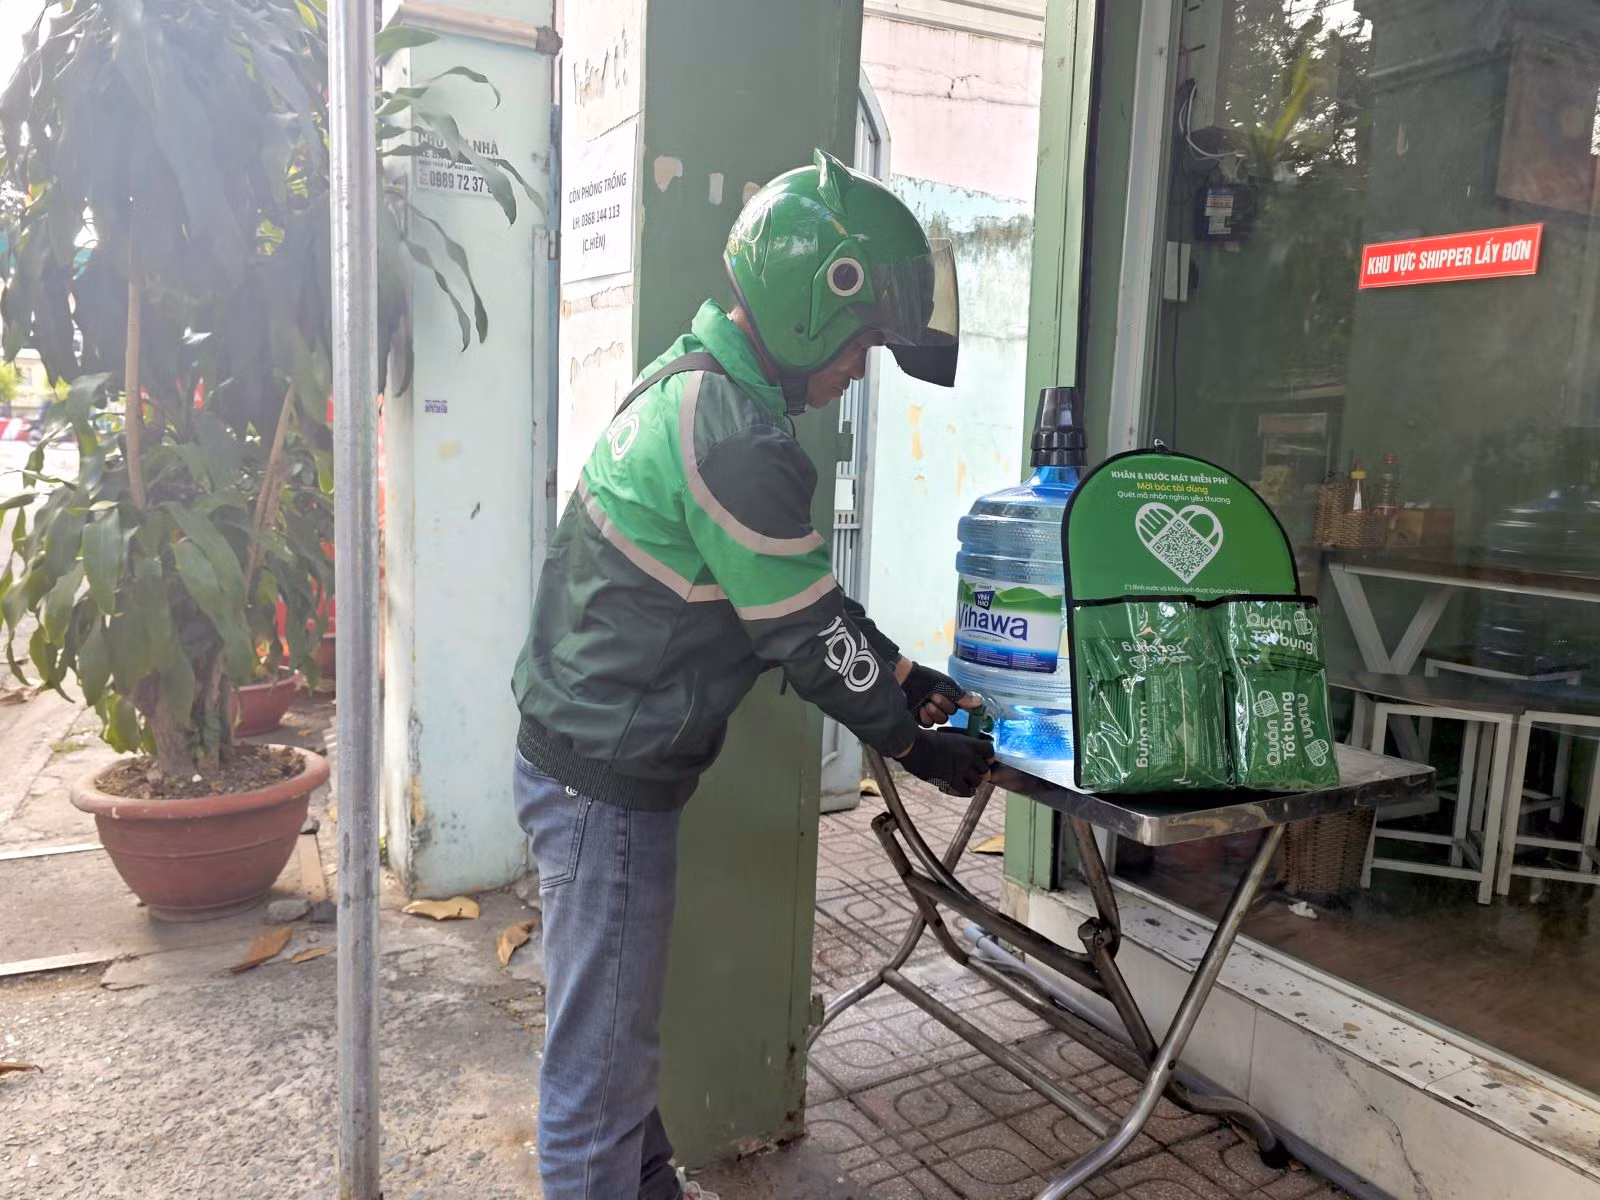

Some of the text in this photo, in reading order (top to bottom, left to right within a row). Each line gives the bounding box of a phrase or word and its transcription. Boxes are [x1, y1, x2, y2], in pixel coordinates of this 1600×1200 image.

[430, 170, 454, 188] 0989
[457, 174, 470, 191] 72
[472, 176, 484, 193] 37
[581, 181, 603, 200] PHÒNG
[604, 170, 627, 192] TRỐNG
[608, 204, 620, 220] 113
[1367, 237, 1532, 276] KHU VỰC SHIPPER LẤY ĐƠN
[1111, 470, 1228, 485] KHĂN & NƯỚC MÁT MIỄN PHÍ
[1136, 482, 1153, 490] Mời
[1154, 482, 1172, 491] bác
[1186, 484, 1209, 495] dùng
[1118, 490, 1136, 499] Quét
[958, 601, 1028, 641] Vihawa
[1247, 612, 1292, 631] Quán
[1280, 632, 1313, 655] bụng
[1281, 691, 1297, 760] Tốt bụng
[1298, 693, 1315, 739] Quán
[1264, 720, 1282, 766] Quán
